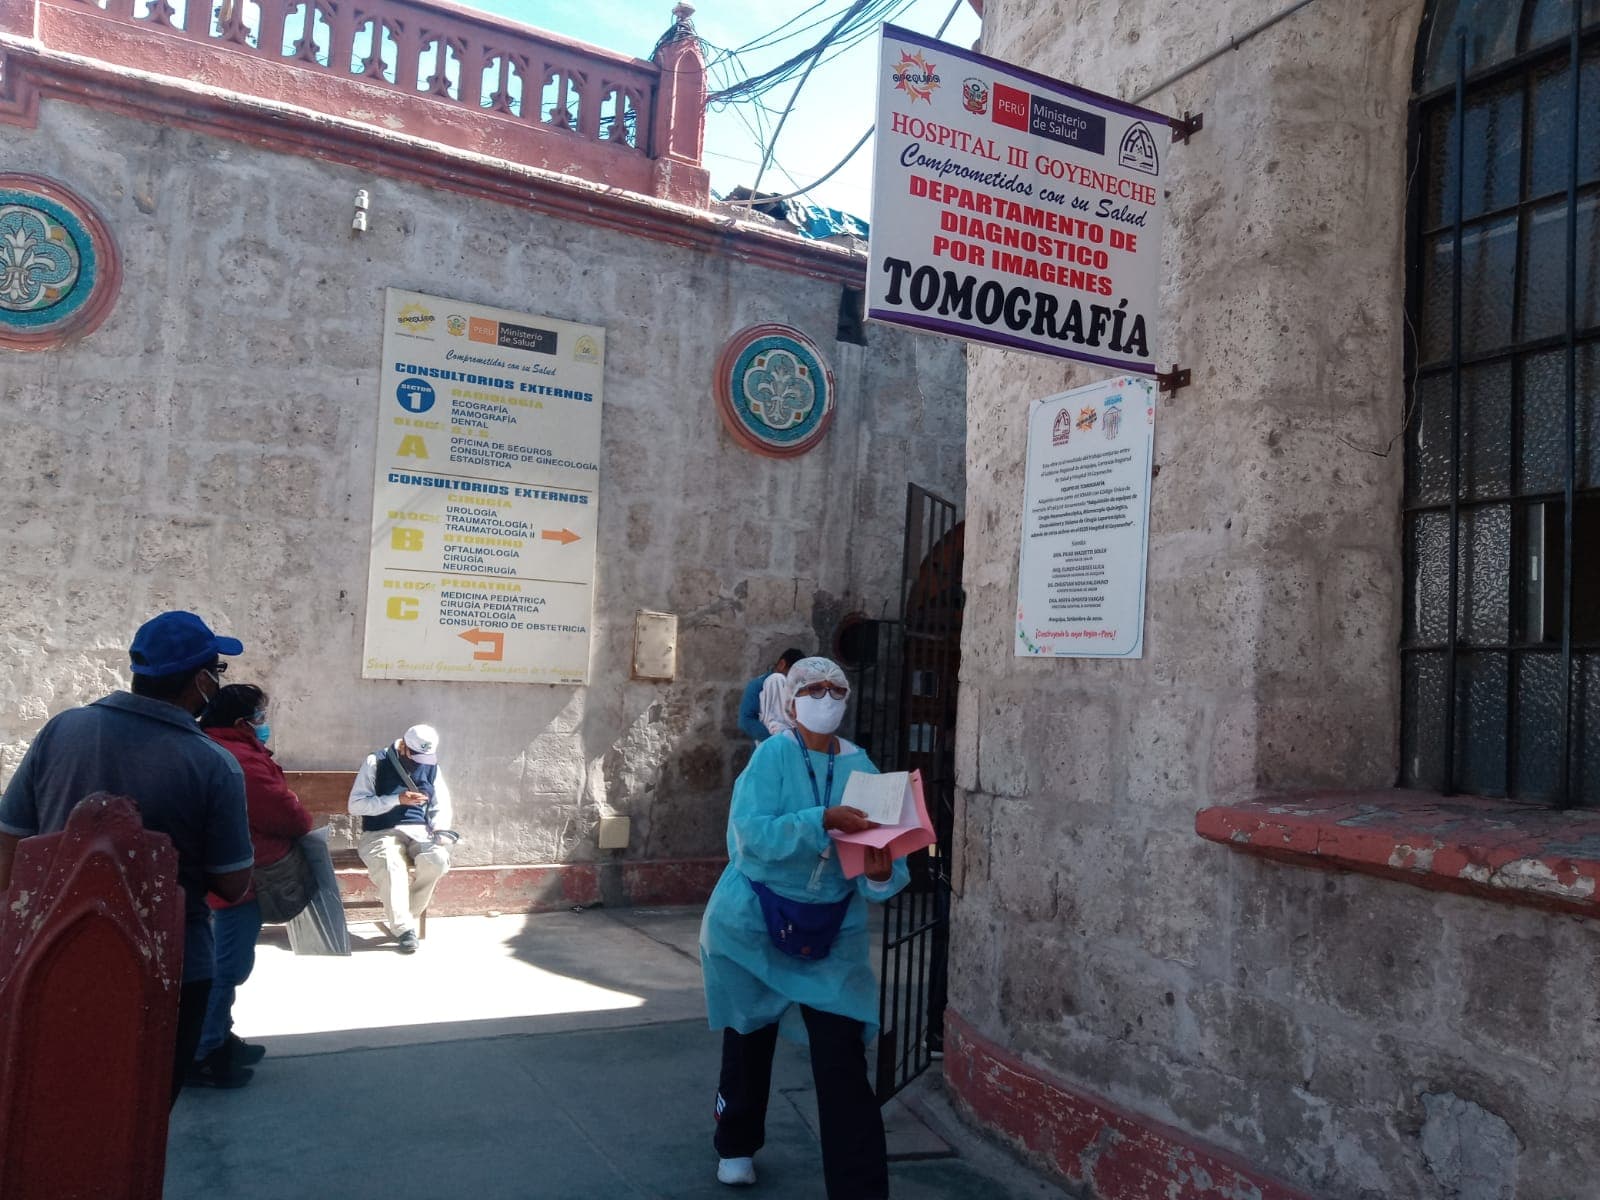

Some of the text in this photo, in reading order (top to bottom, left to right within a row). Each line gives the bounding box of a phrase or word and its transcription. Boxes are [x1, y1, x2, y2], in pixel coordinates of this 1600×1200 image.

[998, 99, 1025, 116] PERÚ
[1033, 103, 1087, 130] Ministerio
[1033, 119, 1078, 140] de Salud
[891, 112, 1156, 206] HOSPITAL III GOYENECHE
[900, 142, 1146, 227] Comprometidos con su Salud
[909, 175, 1137, 253] DEPARTAMENTO DE
[940, 210, 1109, 270] DIAGNOSTICO
[933, 235, 1112, 296] POR IMAGENES
[883, 256, 1150, 357] TOMOGRAFÍA
[473, 325, 495, 336] PERÚ
[500, 327, 543, 342] Ministerio
[512, 338, 536, 348] Salud
[445, 349, 505, 370] Comprometidos
[507, 362, 520, 370] con
[532, 363, 557, 376] Salud
[395, 362, 593, 402] CONSULTORIOS EXTERNOS
[400, 383, 432, 393] SECTOR
[407, 392, 421, 410] 1
[452, 400, 509, 415] ECOGRAFÍA
[451, 408, 517, 425] MAMOGRAFÍA
[451, 417, 489, 429] DENTAL
[396, 433, 430, 459] A
[450, 437, 552, 457] OFICINA DE SEGUROS
[449, 455, 512, 469] ESTADÍSTICA
[450, 446, 598, 471] CONSULTORIO DE GINECOLOGÍA
[388, 472, 589, 505] CONSULTORIOS EXTERNOS
[446, 505, 498, 518] UROLOGÍA
[446, 515, 528, 529] TRAUMATOLOGÍA
[391, 526, 424, 552] B
[445, 523, 535, 539] TRAUMATOLOGÍA II
[443, 544, 520, 558] OFTALMOLOGÍA
[443, 554, 484, 564] CIRUGÍA
[442, 563, 517, 575] NEUROCIRUGÍA
[440, 591, 546, 605] MEDICINA PEDIÁTRICA
[440, 600, 539, 613] CIRUGÍA PEDIÁTRICA
[386, 596, 420, 621] C
[440, 609, 516, 620] NEONATOLOGÍA
[439, 618, 586, 633] CONSULTORIO DE OBSTETRICIA
